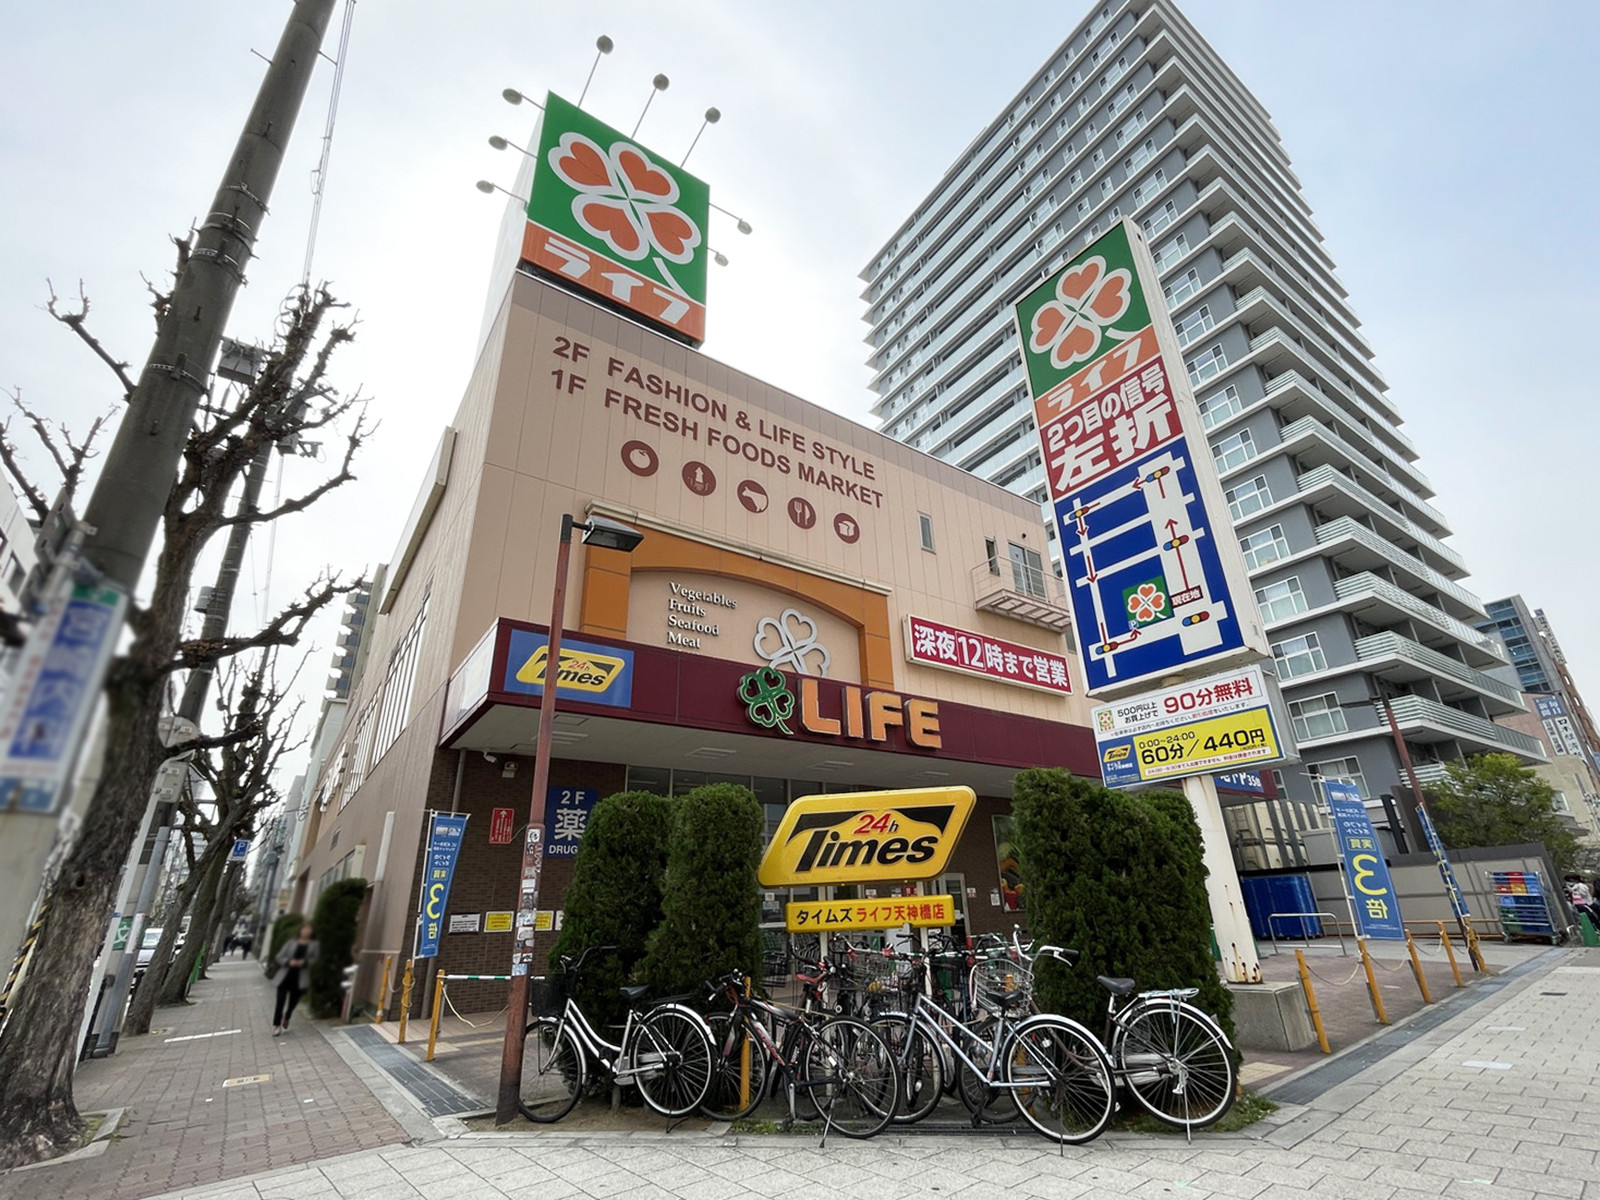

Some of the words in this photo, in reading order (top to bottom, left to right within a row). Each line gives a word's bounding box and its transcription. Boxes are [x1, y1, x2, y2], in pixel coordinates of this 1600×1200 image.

[544, 236, 690, 325] ライフ
[1048, 338, 1142, 412] ライフ
[553, 336, 590, 363] 2F
[607, 357, 727, 421] FASHION
[735, 410, 751, 431] &
[759, 419, 805, 453] LIFE
[812, 441, 876, 481] STYLE
[1047, 362, 1165, 453] 2つ目の信号
[551, 369, 587, 395] 1F
[604, 388, 698, 441] FRESH
[707, 427, 791, 474] FOODS
[798, 462, 883, 508] MARKET
[1051, 393, 1172, 492] 左折
[668, 597, 707, 618] Fruits
[669, 581, 738, 609] Vegetables
[1171, 588, 1201, 606] 現在地
[667, 613, 720, 637] Seafood
[667, 631, 701, 649] Meat
[914, 624, 1068, 688] 深夜12時まで営業
[1117, 702, 1157, 718] 500円以上
[1164, 677, 1253, 714] 90分無料
[799, 678, 942, 749] LIFE
[560, 790, 586, 805] 2F
[554, 808, 588, 841] 薬
[853, 813, 899, 835] 24h
[795, 829, 938, 873] Times
[796, 907, 853, 926] タイムズ
[857, 903, 945, 923] ライフ天神橋店
